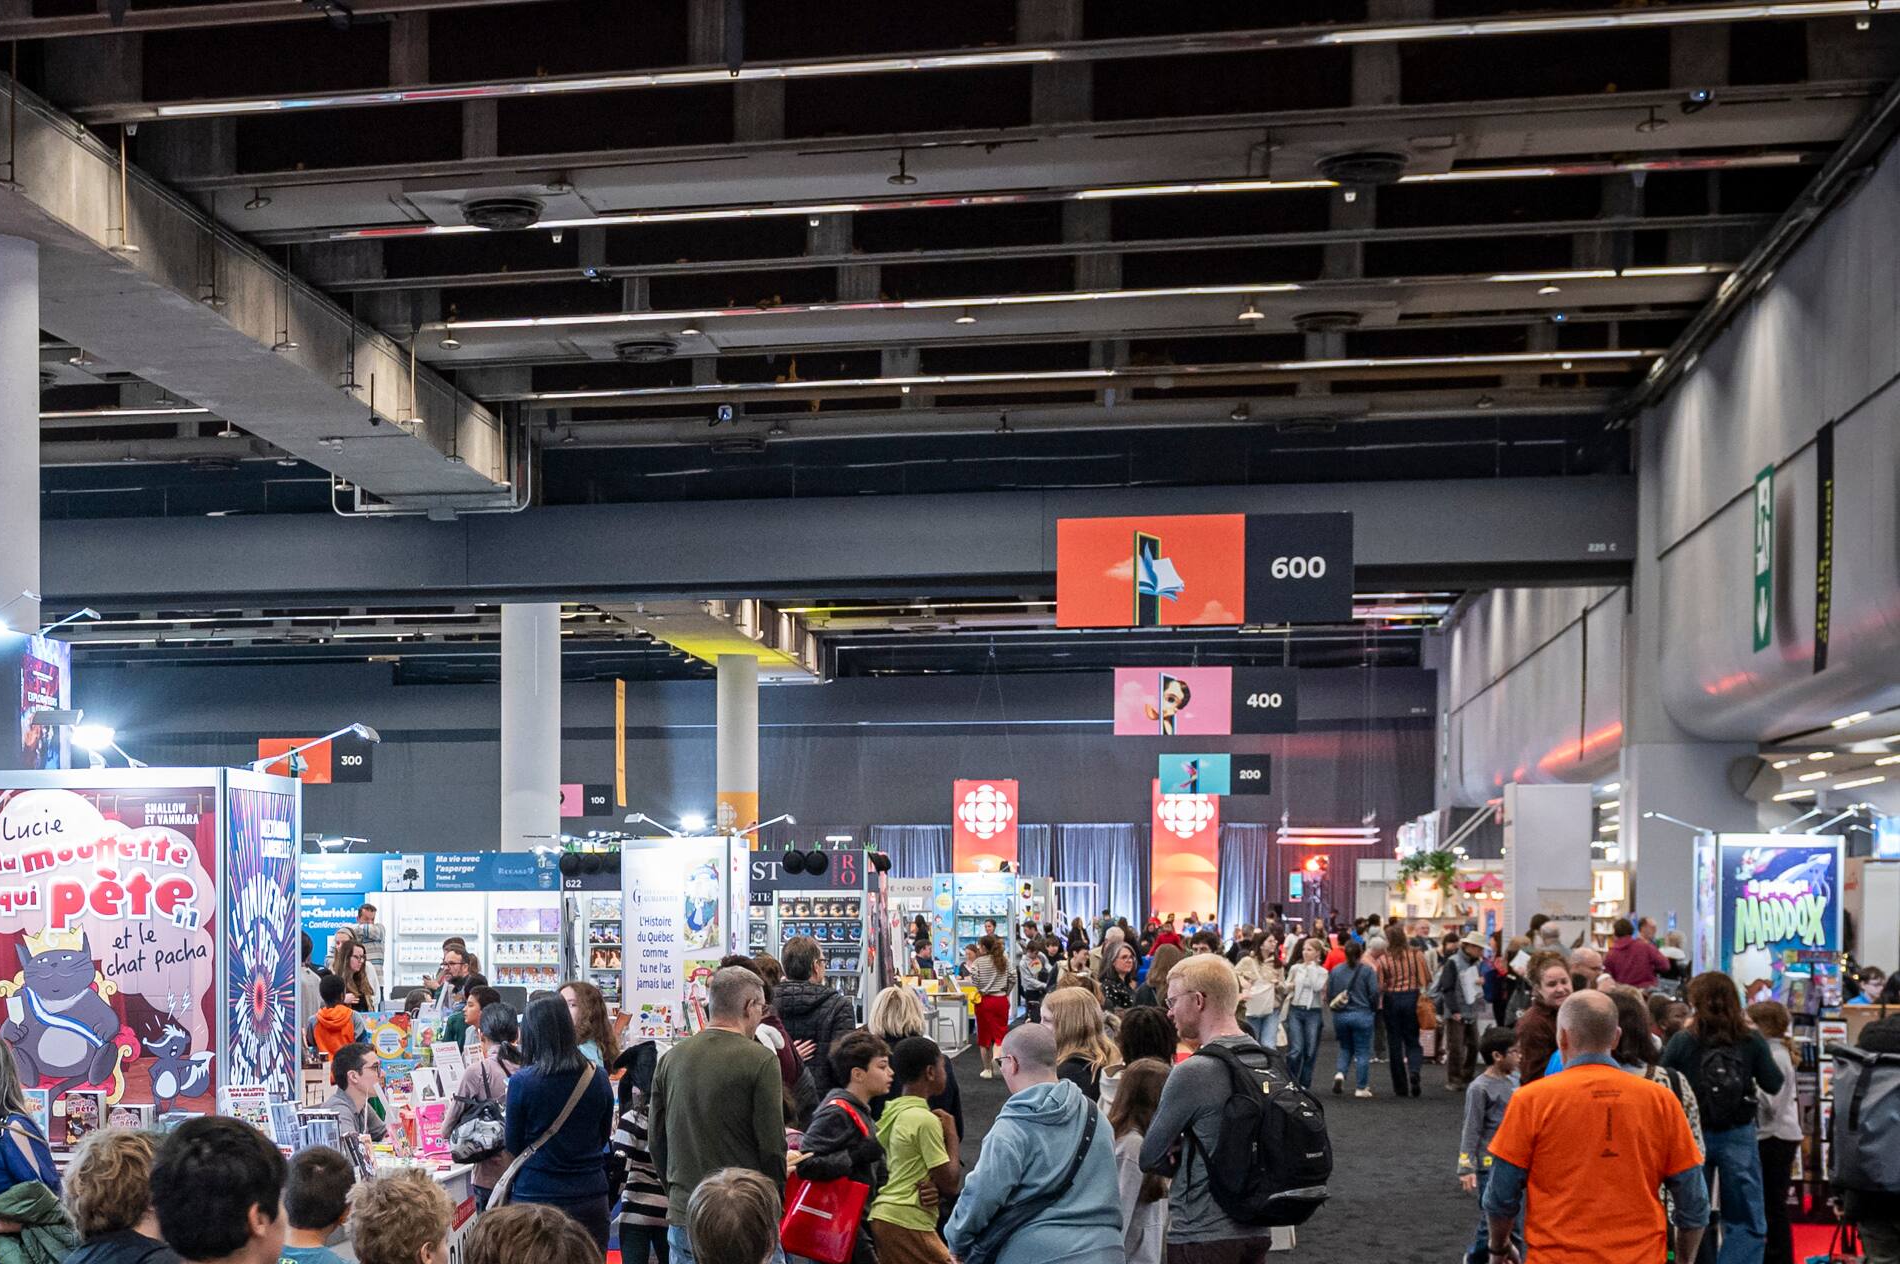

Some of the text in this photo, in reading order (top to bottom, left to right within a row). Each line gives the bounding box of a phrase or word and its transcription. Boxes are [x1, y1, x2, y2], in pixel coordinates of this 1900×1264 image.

[1271, 556, 1326, 579] 600
[1246, 692, 1282, 708] 400
[340, 755, 363, 766] 300
[1239, 769, 1261, 779] 200
[590, 796, 605, 805] 100
[145, 803, 186, 814] SHALLOW
[2, 809, 64, 841] Lucie
[145, 814, 199, 825] ET VANNARA
[21, 833, 189, 873] mouffette
[435, 855, 480, 863] Ma vie avec
[435, 864, 475, 874] l'asperger
[565, 879, 582, 889] 622
[49, 866, 195, 930] pète
[639, 916, 672, 928] L'Histoire
[1734, 893, 1828, 954] MADDOX
[112, 922, 158, 950] et le
[637, 931, 674, 945] du Québec
[106, 938, 207, 977] chat pacha
[642, 949, 669, 958] comme
[639, 963, 672, 974] tu ne l'as
[636, 977, 675, 991] jamais lue!
